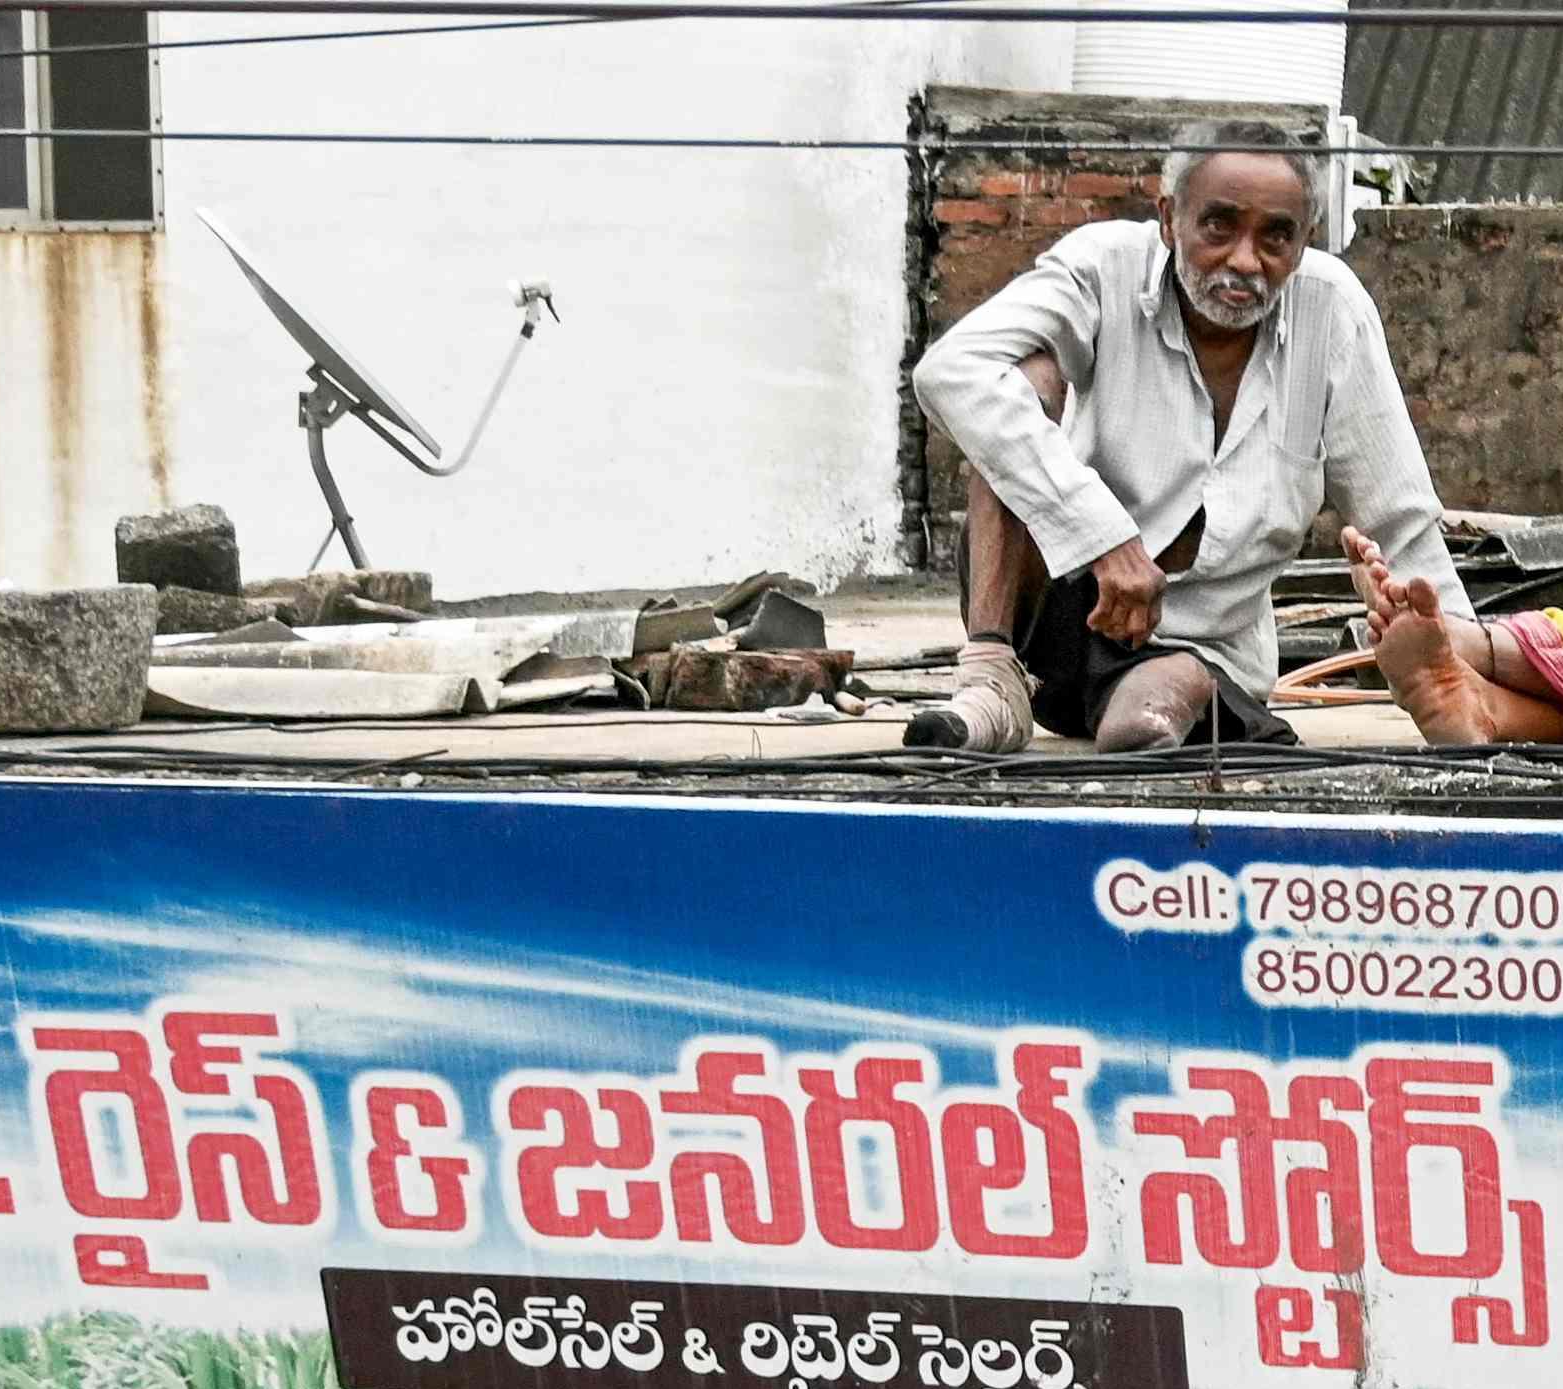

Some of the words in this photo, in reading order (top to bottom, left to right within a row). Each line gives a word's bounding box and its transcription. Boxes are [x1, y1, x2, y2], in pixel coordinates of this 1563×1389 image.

[1108, 872, 1229, 920] Cell:
[33, 1010, 324, 1291] రైస్
[365, 1085, 470, 1235] &
[507, 1045, 1090, 1265] జనరల్
[1134, 1055, 1551, 1371] స్టోర్స్
[682, 1333, 726, 1375] &
